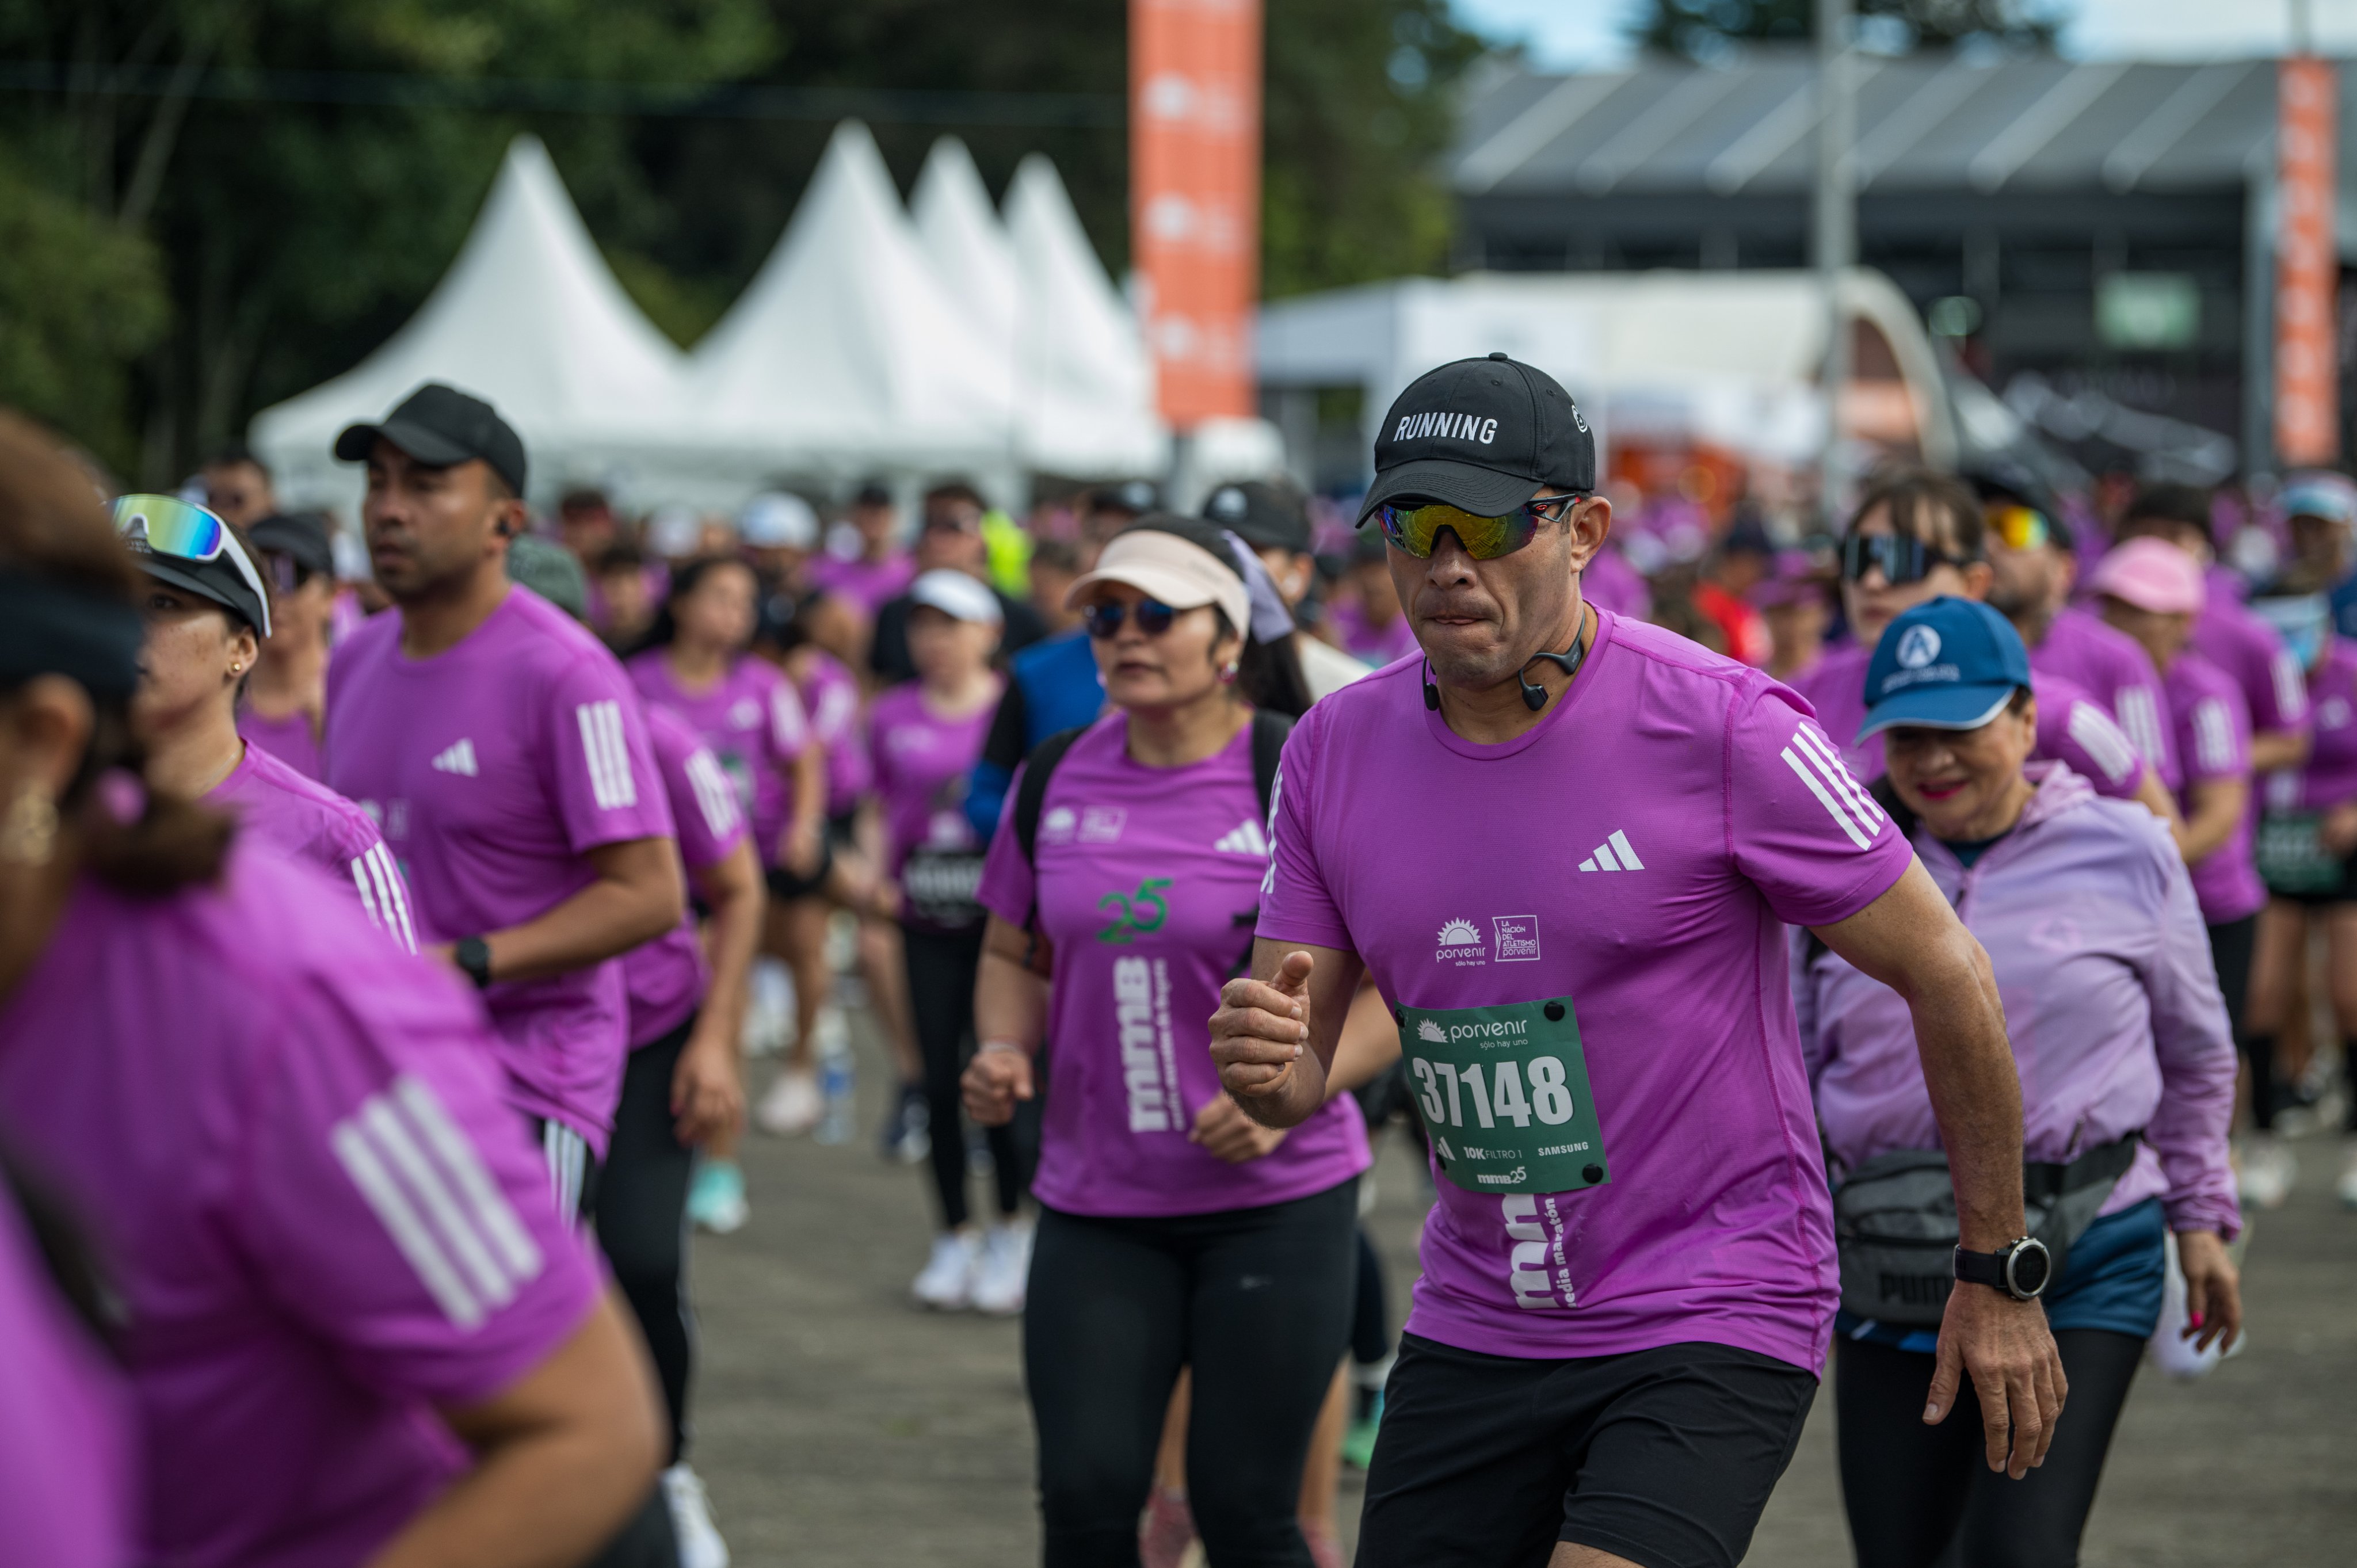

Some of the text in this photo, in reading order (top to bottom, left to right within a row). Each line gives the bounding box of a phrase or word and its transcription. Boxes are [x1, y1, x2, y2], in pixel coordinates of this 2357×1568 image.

[1393, 412, 1498, 444] RUNNING
[1098, 878, 1172, 943] 25
[1502, 925, 1525, 933] NACIÓN
[1502, 939, 1536, 947] ATLETISMO
[1503, 948, 1536, 957] porvenir
[1436, 947, 1486, 963] porvenir
[1450, 1020, 1527, 1043] porvenir
[1480, 1040, 1495, 1049] sólo
[1497, 1040, 1511, 1048] hay
[1413, 1056, 1573, 1128] 37148
[1538, 1142, 1589, 1156] SAMSUNG
[1544, 1198, 1566, 1266] maratón
[1879, 1271, 1949, 1304] PUM
